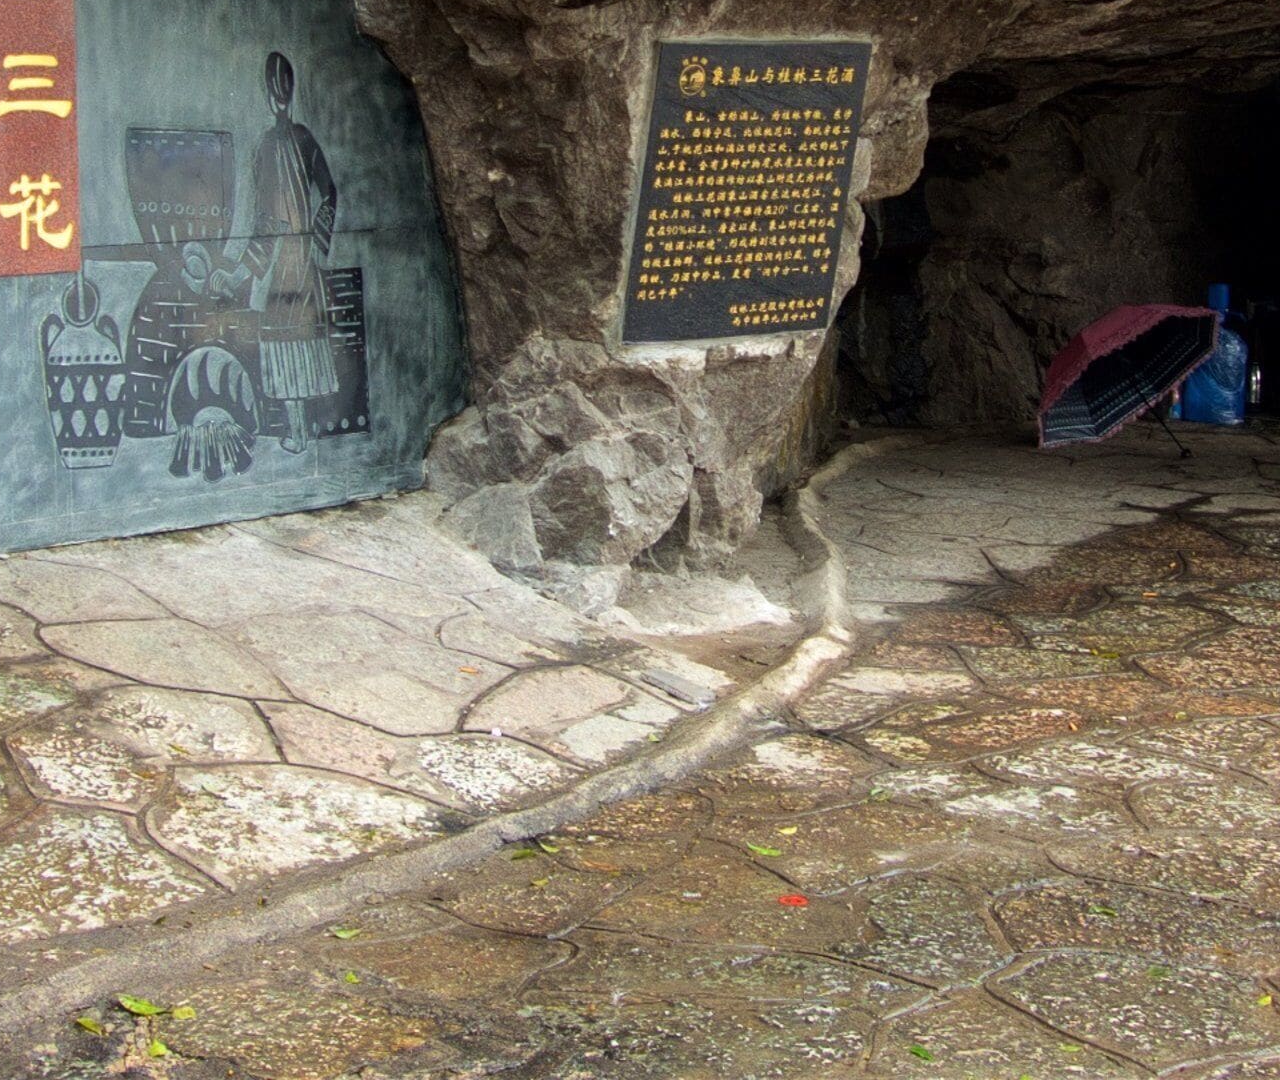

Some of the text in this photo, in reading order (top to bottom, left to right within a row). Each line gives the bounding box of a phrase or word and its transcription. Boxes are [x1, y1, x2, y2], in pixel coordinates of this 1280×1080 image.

[712, 66, 855, 86] 象鼻山与桂林三花酒
